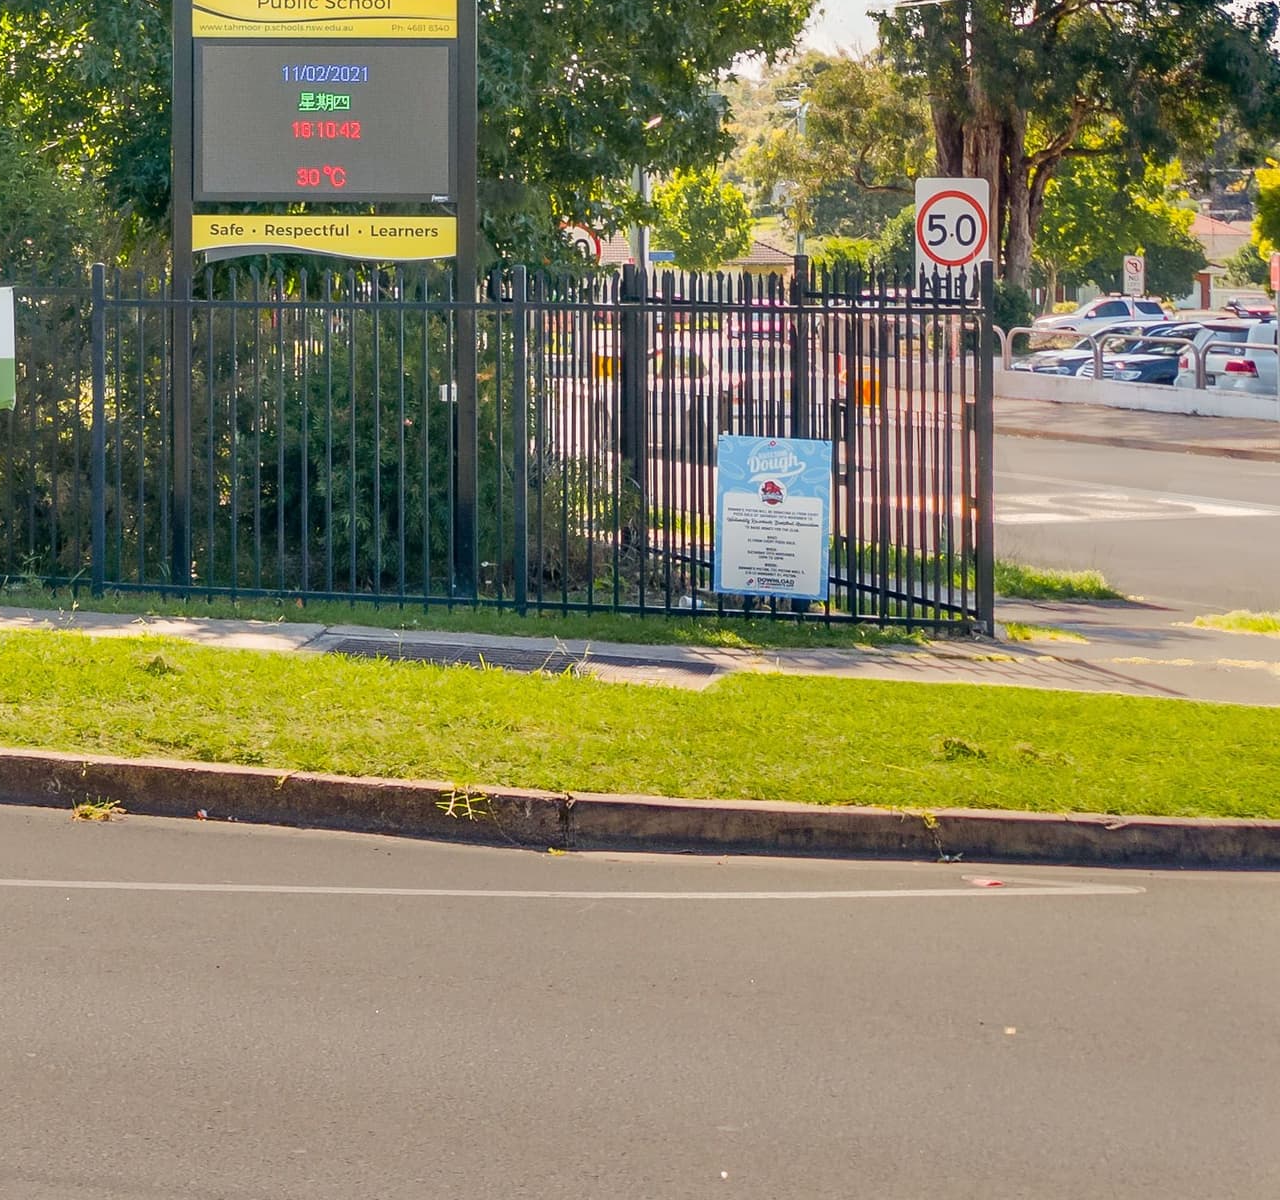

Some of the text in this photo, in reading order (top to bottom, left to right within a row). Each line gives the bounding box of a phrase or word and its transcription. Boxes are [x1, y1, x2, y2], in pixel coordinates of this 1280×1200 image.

[282, 65, 368, 82] 11/02/2021
[298, 92, 350, 111] 星期四
[296, 167, 320, 186] 30
[209, 223, 439, 239] Safe Respectful Learners
[927, 213, 977, 246] 50
[747, 451, 798, 473] Dough
